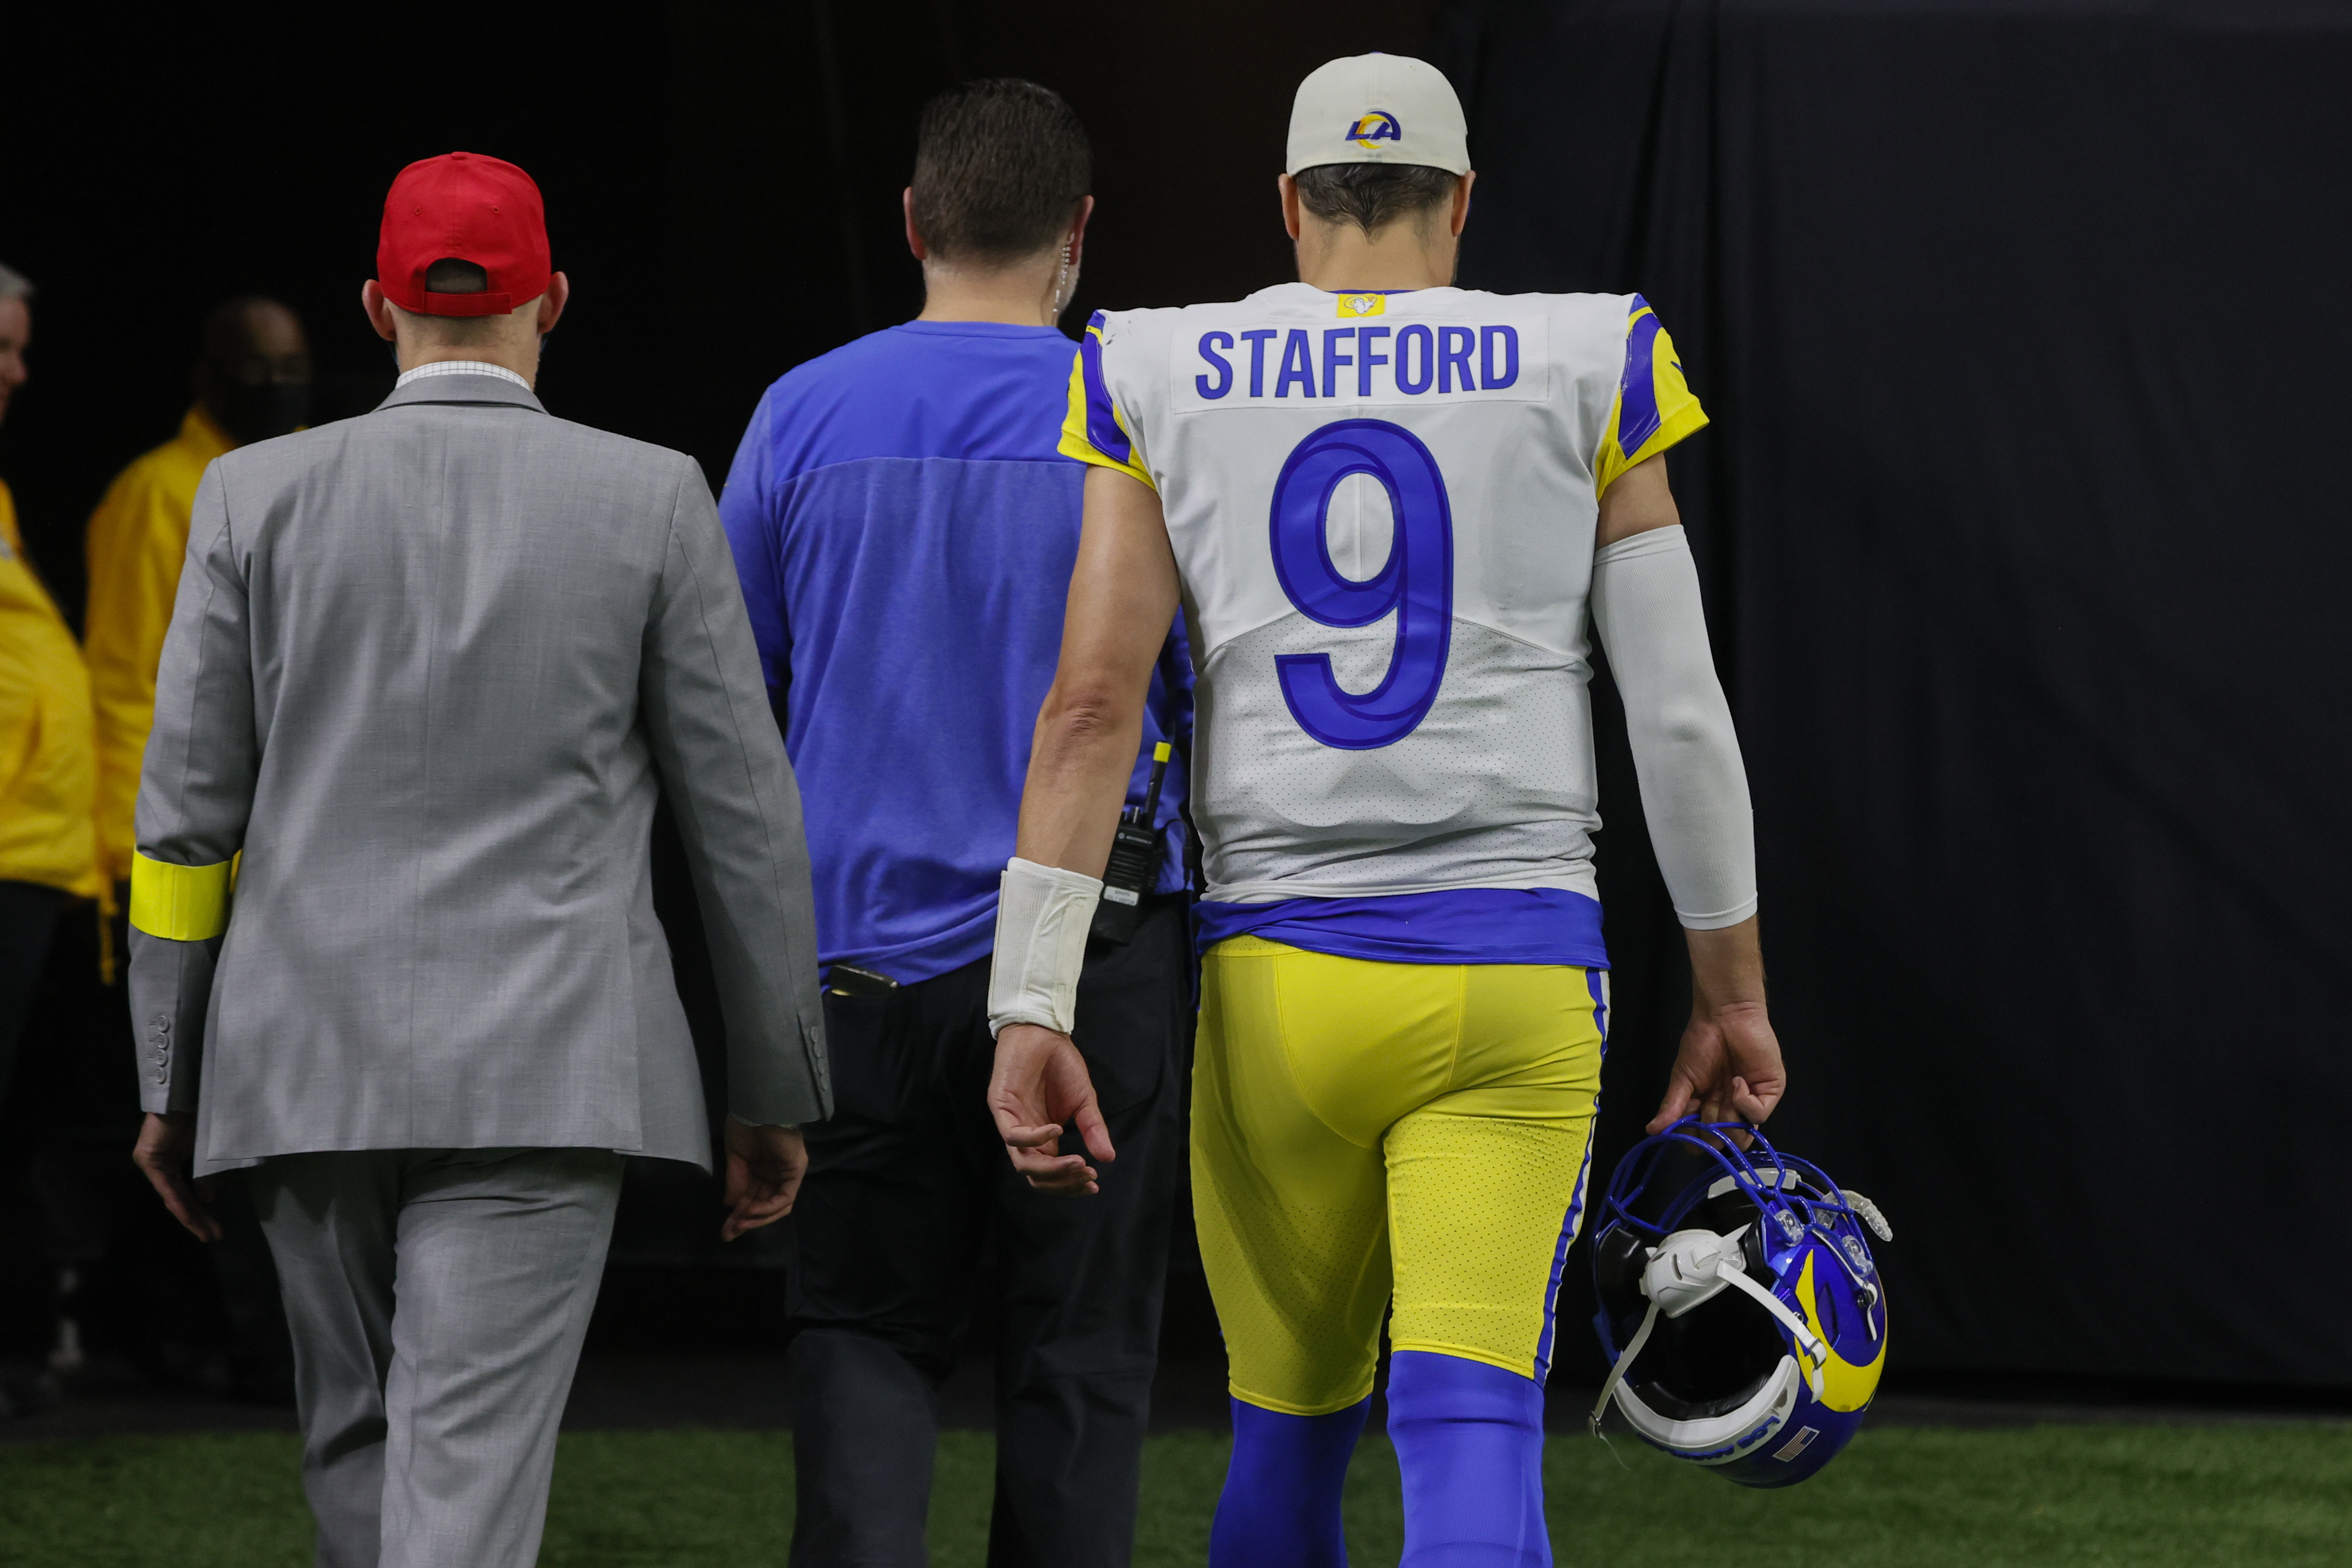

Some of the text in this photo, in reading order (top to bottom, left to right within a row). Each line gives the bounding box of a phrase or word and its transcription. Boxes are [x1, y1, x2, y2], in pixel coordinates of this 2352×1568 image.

[1345, 111, 1401, 141] LA
[1196, 324, 1519, 400] STAFFORD
[1270, 418, 1453, 750] 9
